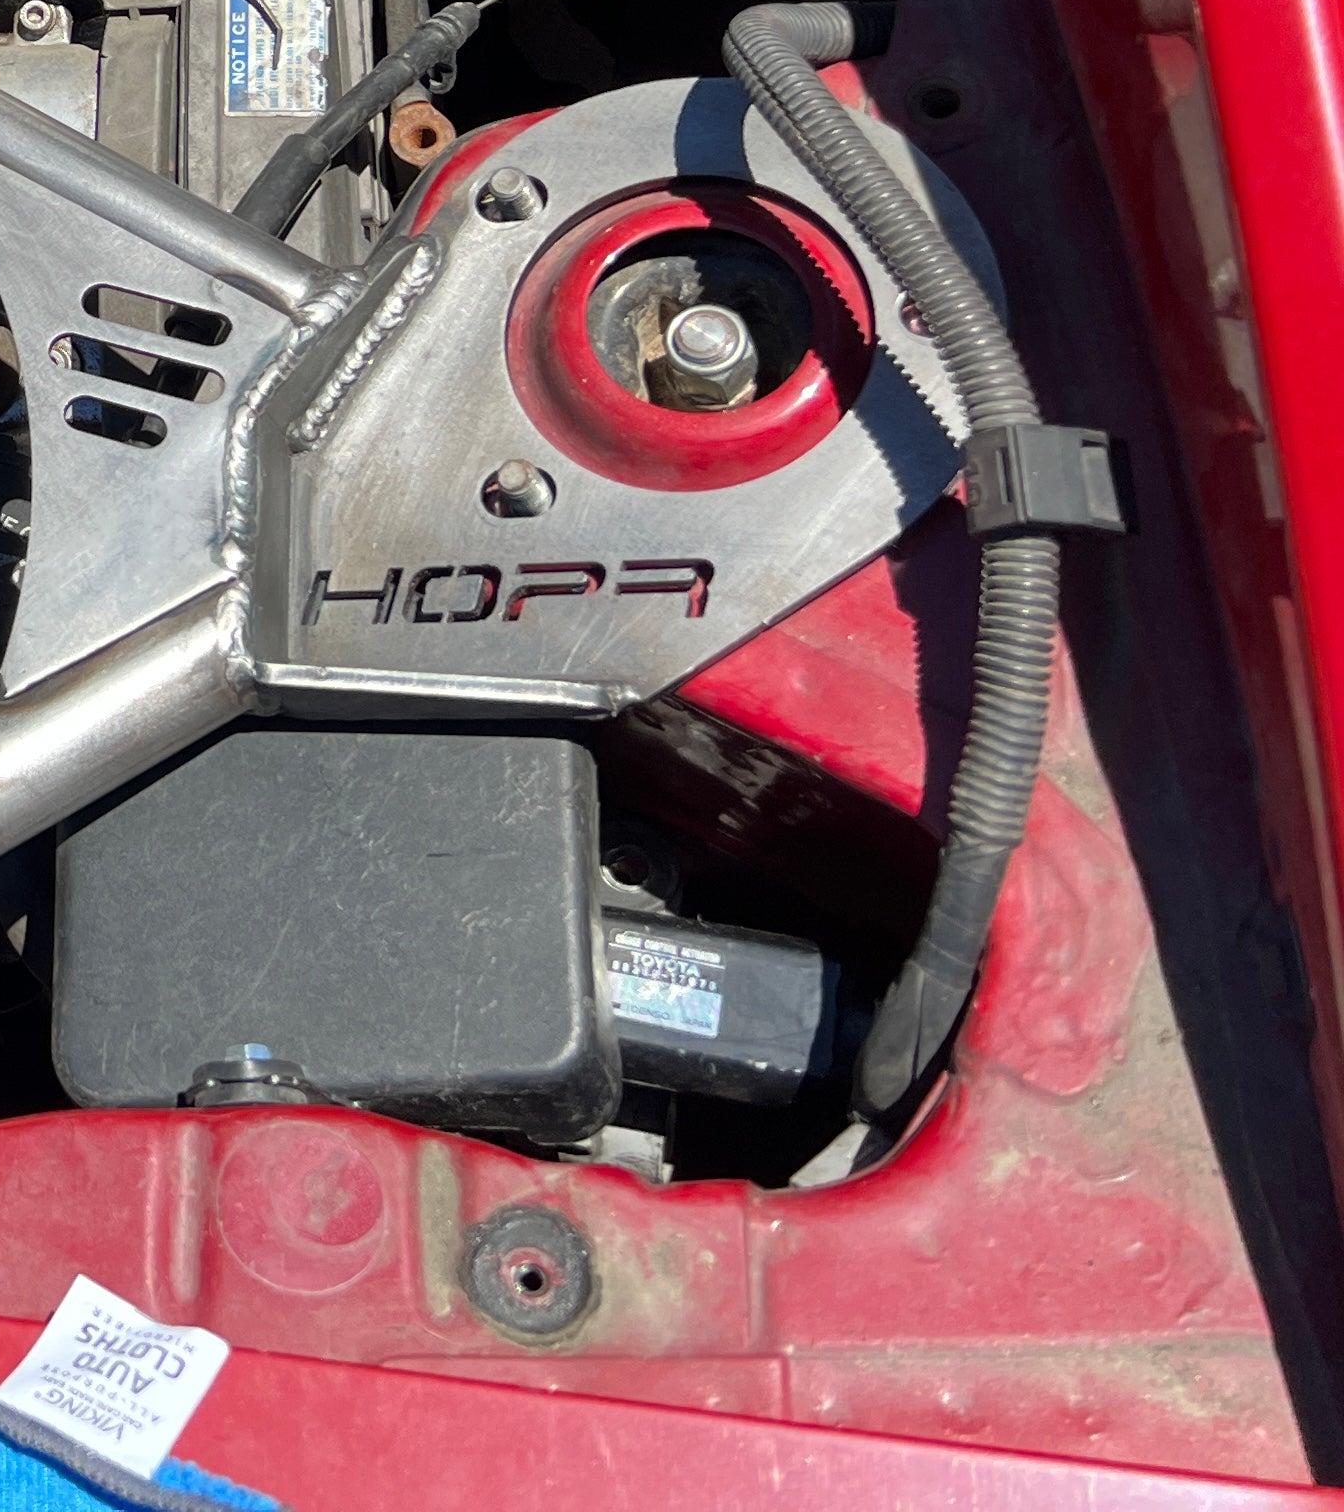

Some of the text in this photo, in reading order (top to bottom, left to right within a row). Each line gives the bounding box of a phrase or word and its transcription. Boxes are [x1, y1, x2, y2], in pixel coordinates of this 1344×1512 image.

[231, 11, 246, 85] NOTICE
[300, 558, 715, 626] HOPR
[630, 950, 701, 978] TOYOTA
[74, 1323, 187, 1380] CLOTHS
[92, 1306, 196, 1354] MICROFIBER
[72, 1351, 156, 1395] AUTO
